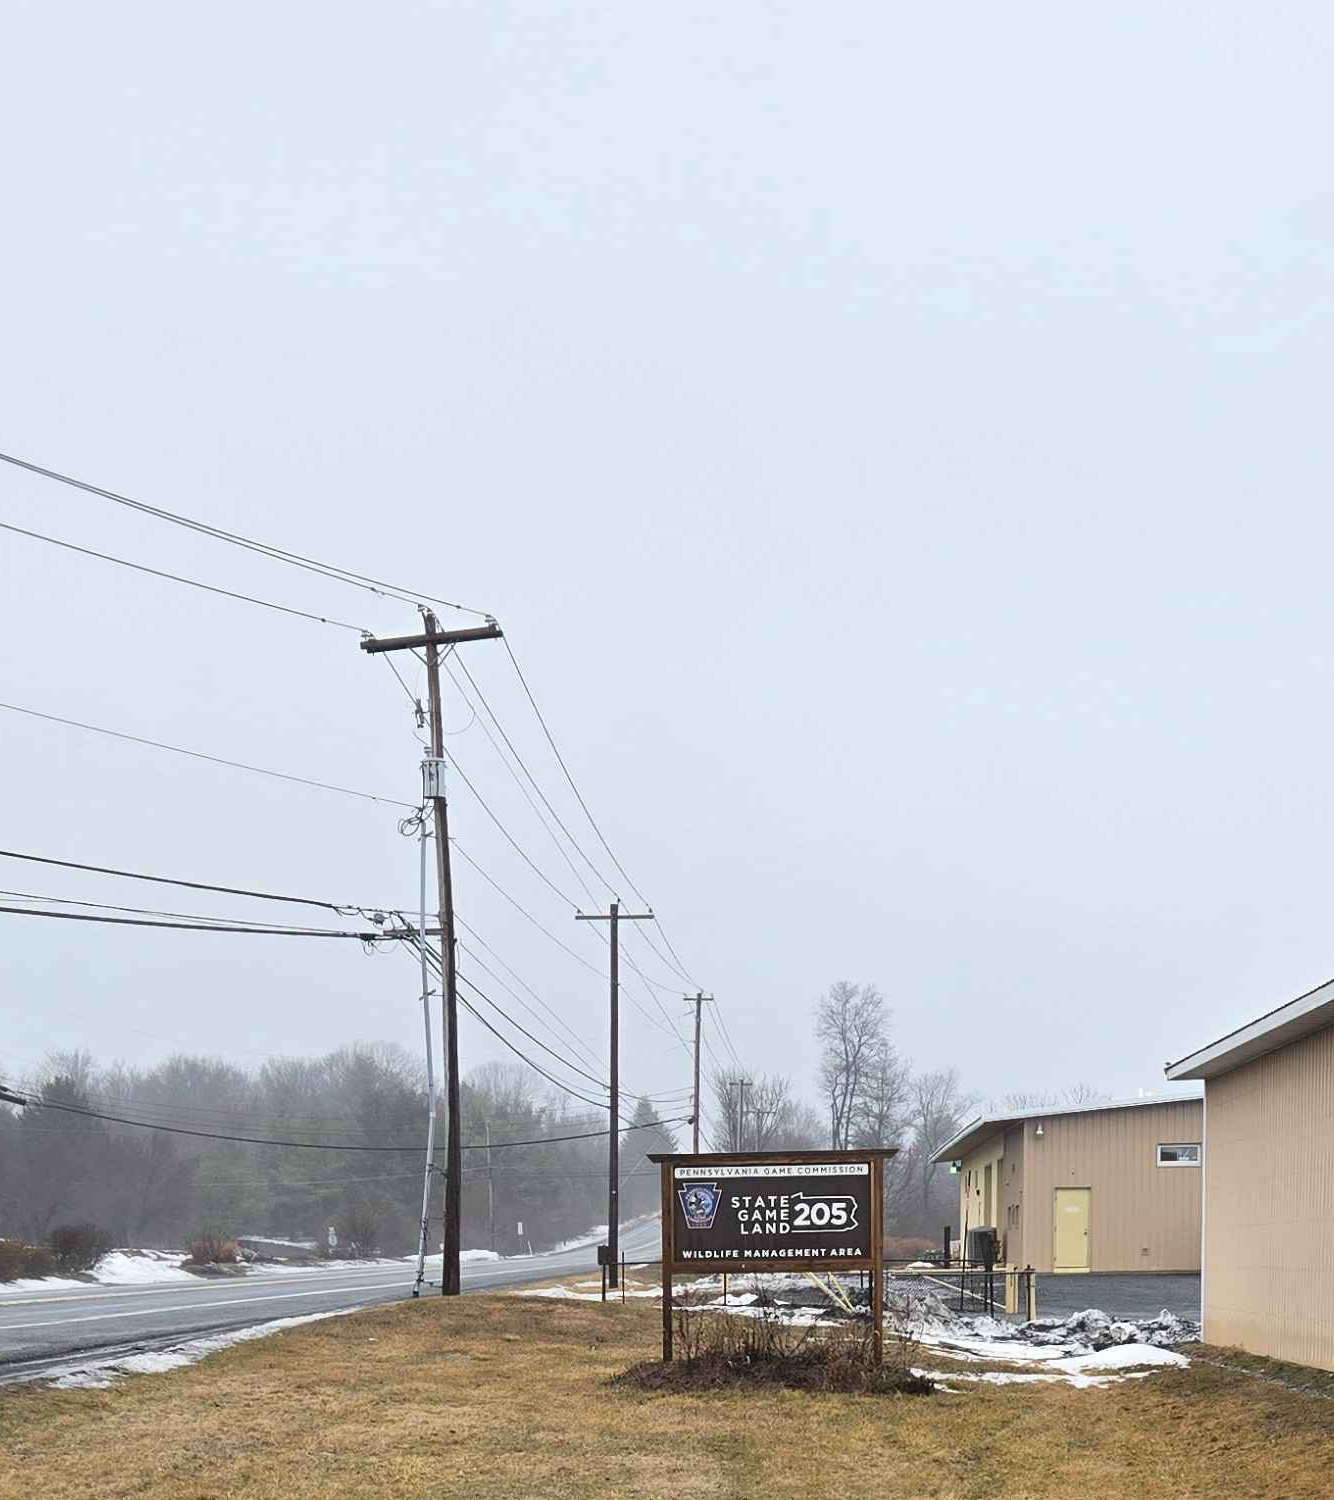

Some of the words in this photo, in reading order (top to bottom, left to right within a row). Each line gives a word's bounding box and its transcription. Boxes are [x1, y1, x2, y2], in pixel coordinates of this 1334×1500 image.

[679, 1167, 759, 1177] PENNSYLVANIA
[763, 1166, 793, 1176] GAME
[796, 1165, 864, 1175] COMMISSION
[730, 1195, 790, 1209] STATE
[737, 1209, 790, 1222] GAME
[792, 1202, 848, 1227] 205
[740, 1222, 791, 1235] LAND
[682, 1250, 740, 1259] WILDLIFE
[743, 1248, 827, 1258] MANAGEMENT
[829, 1247, 863, 1257] AREA
